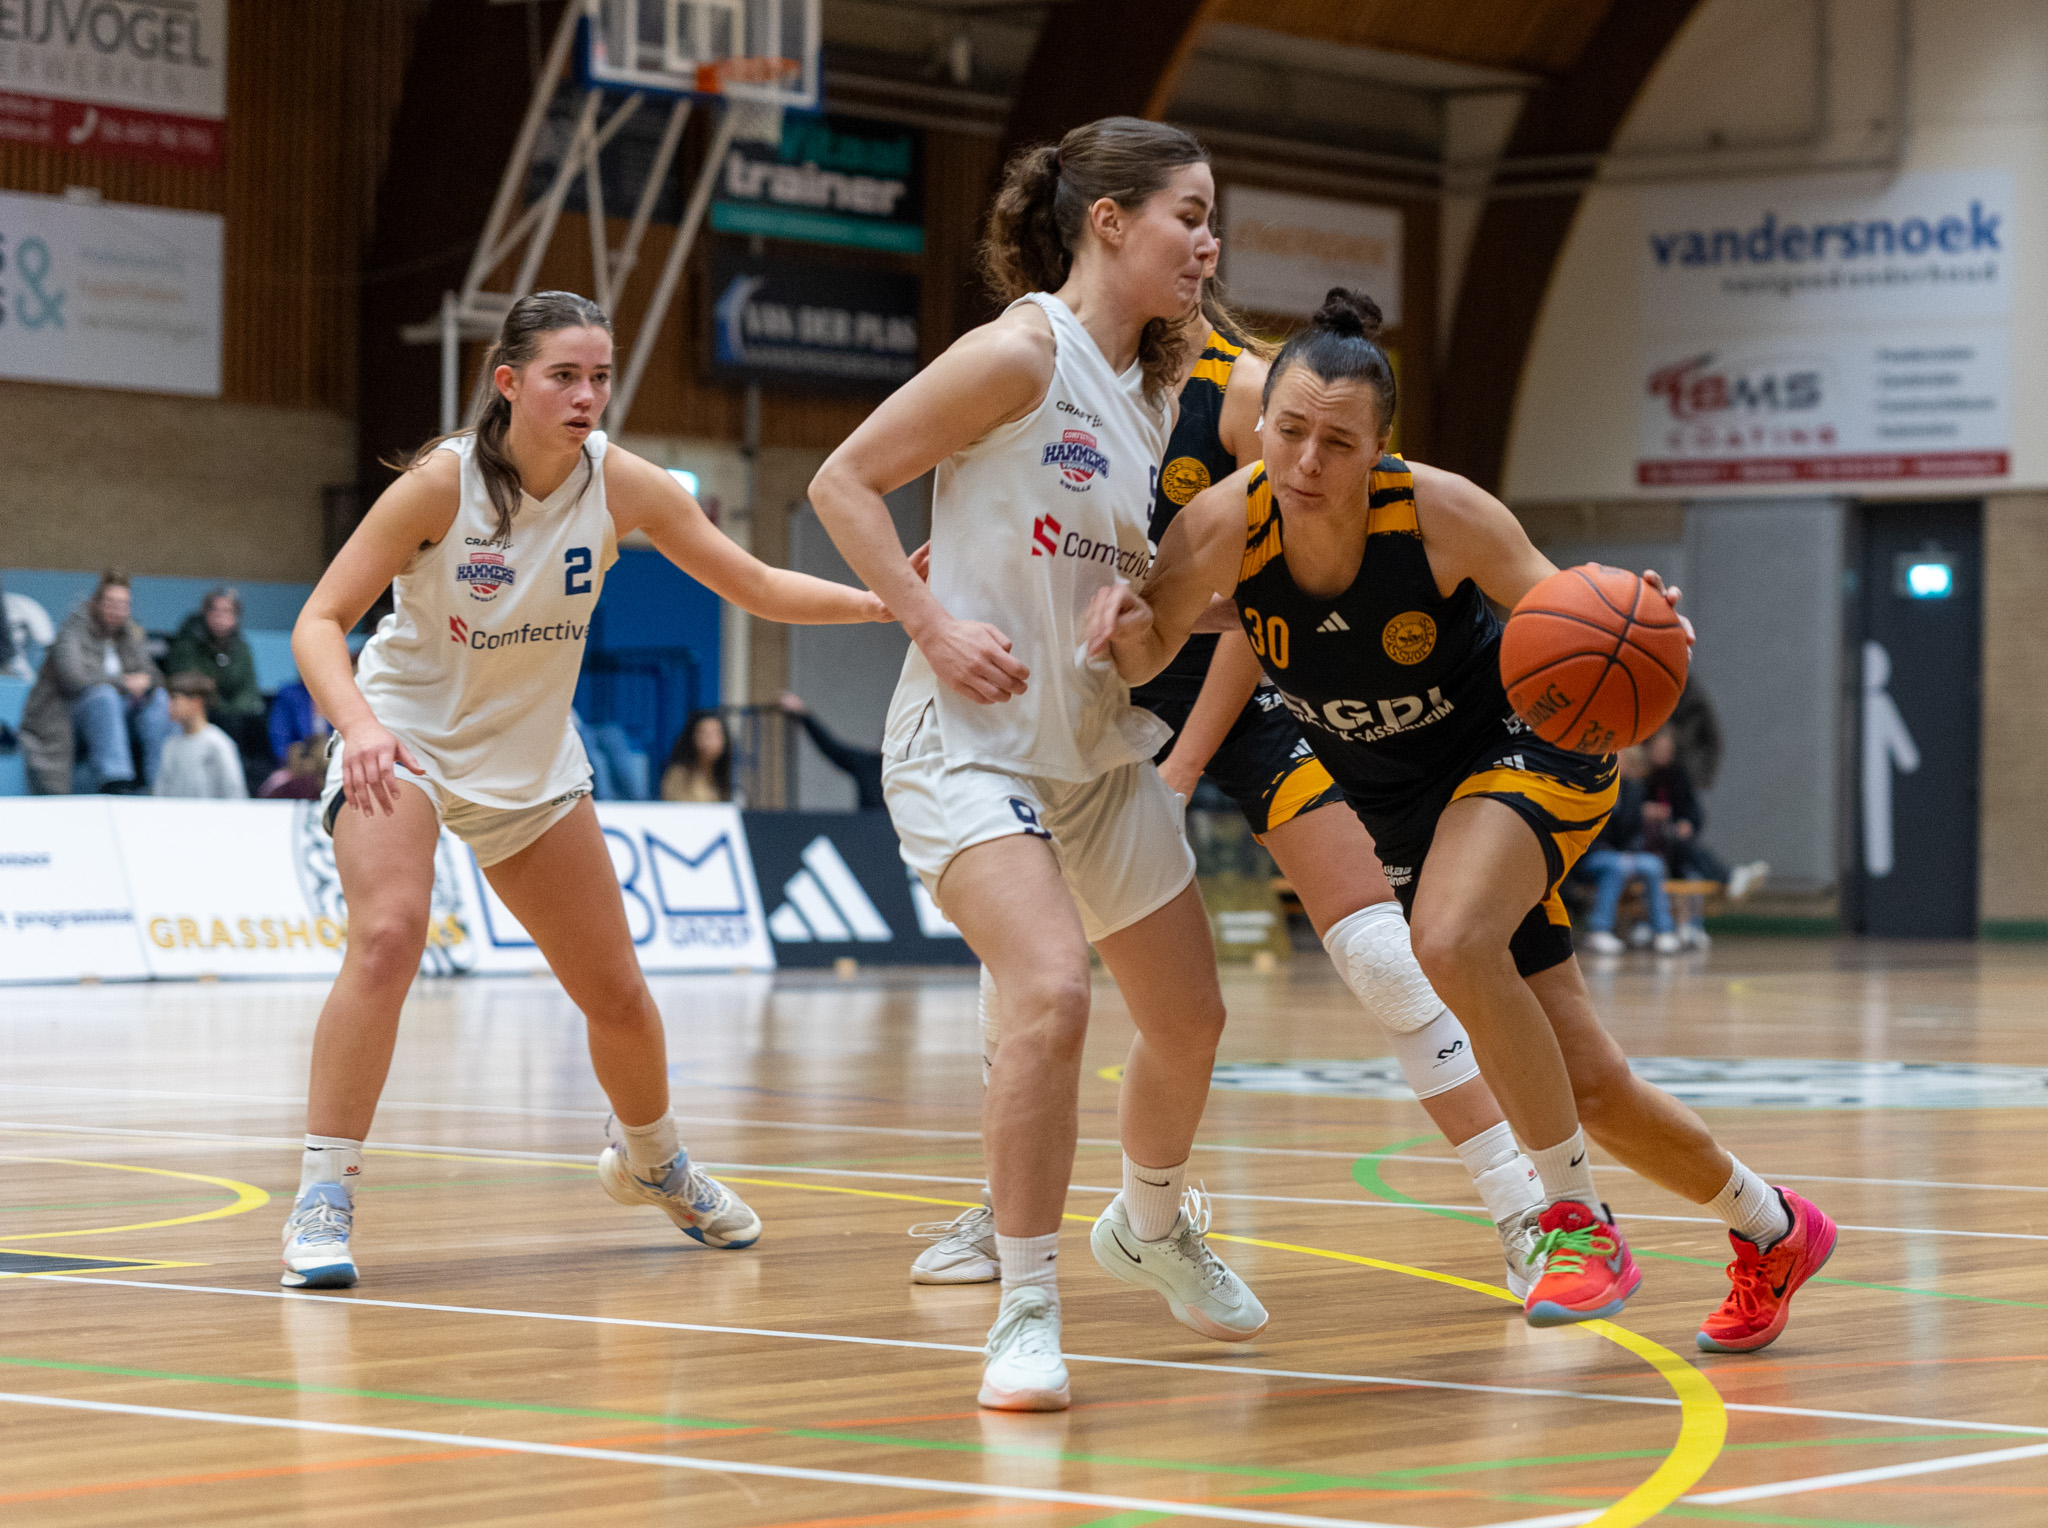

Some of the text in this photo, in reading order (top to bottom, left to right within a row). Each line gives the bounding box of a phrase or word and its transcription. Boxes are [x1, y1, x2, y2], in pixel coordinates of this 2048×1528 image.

[723, 150, 906, 217] trainer
[1649, 199, 2004, 268] vandersnoek
[1056, 400, 1092, 424] CRAFT
[1043, 443, 1108, 478] HAMMERS
[464, 536, 503, 549] CRAFT
[456, 563, 516, 584] HAMMERS
[564, 546, 593, 596] 2
[1244, 607, 1289, 670] 30
[1009, 797, 1052, 840] 9
[666, 916, 751, 948] GROEP
